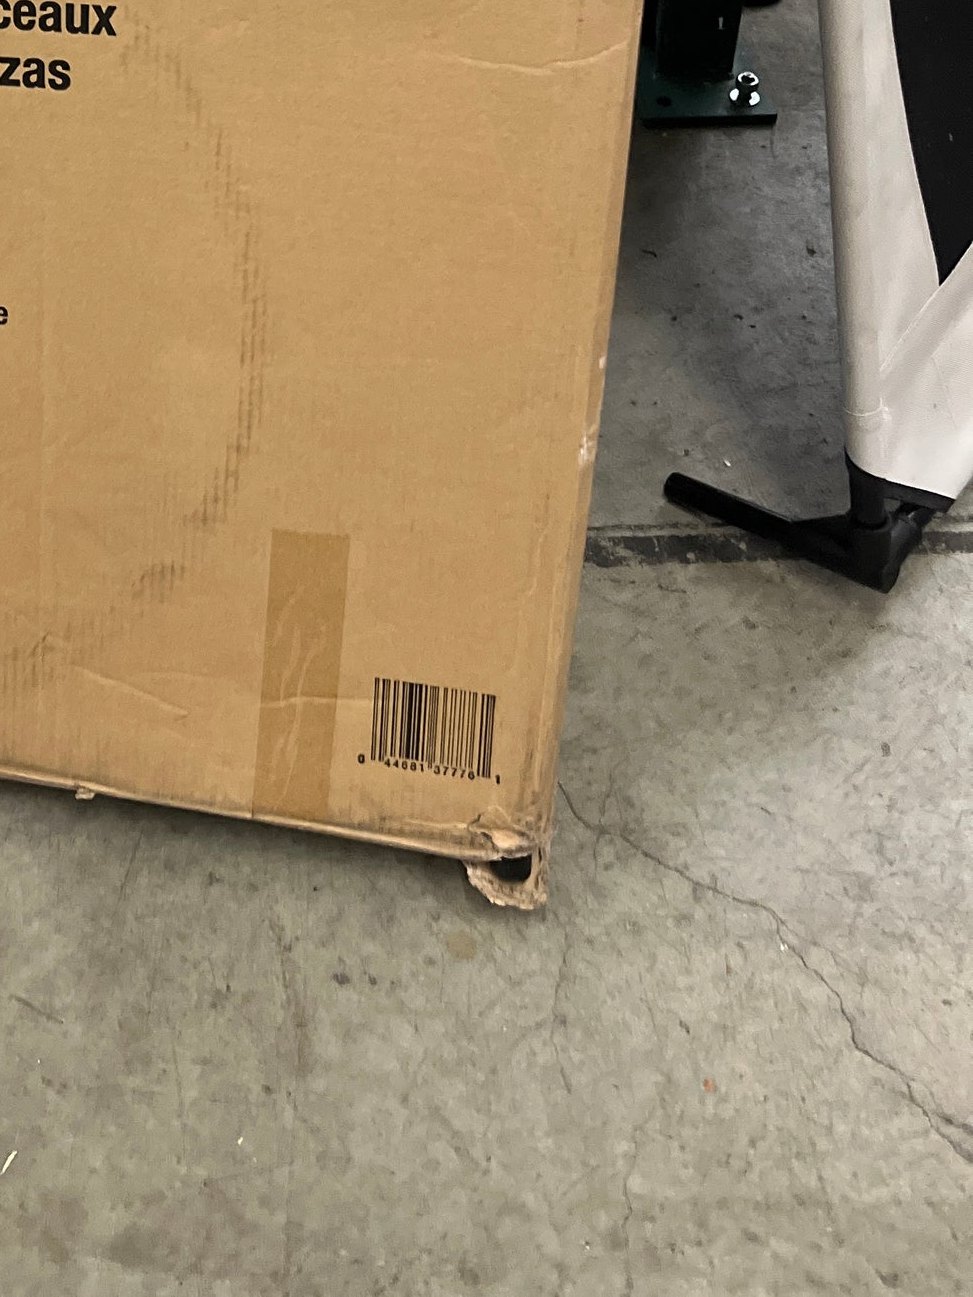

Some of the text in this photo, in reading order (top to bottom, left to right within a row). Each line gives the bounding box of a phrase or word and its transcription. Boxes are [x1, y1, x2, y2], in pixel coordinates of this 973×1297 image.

[357, 753, 501, 785] 0 44681 37776 1
